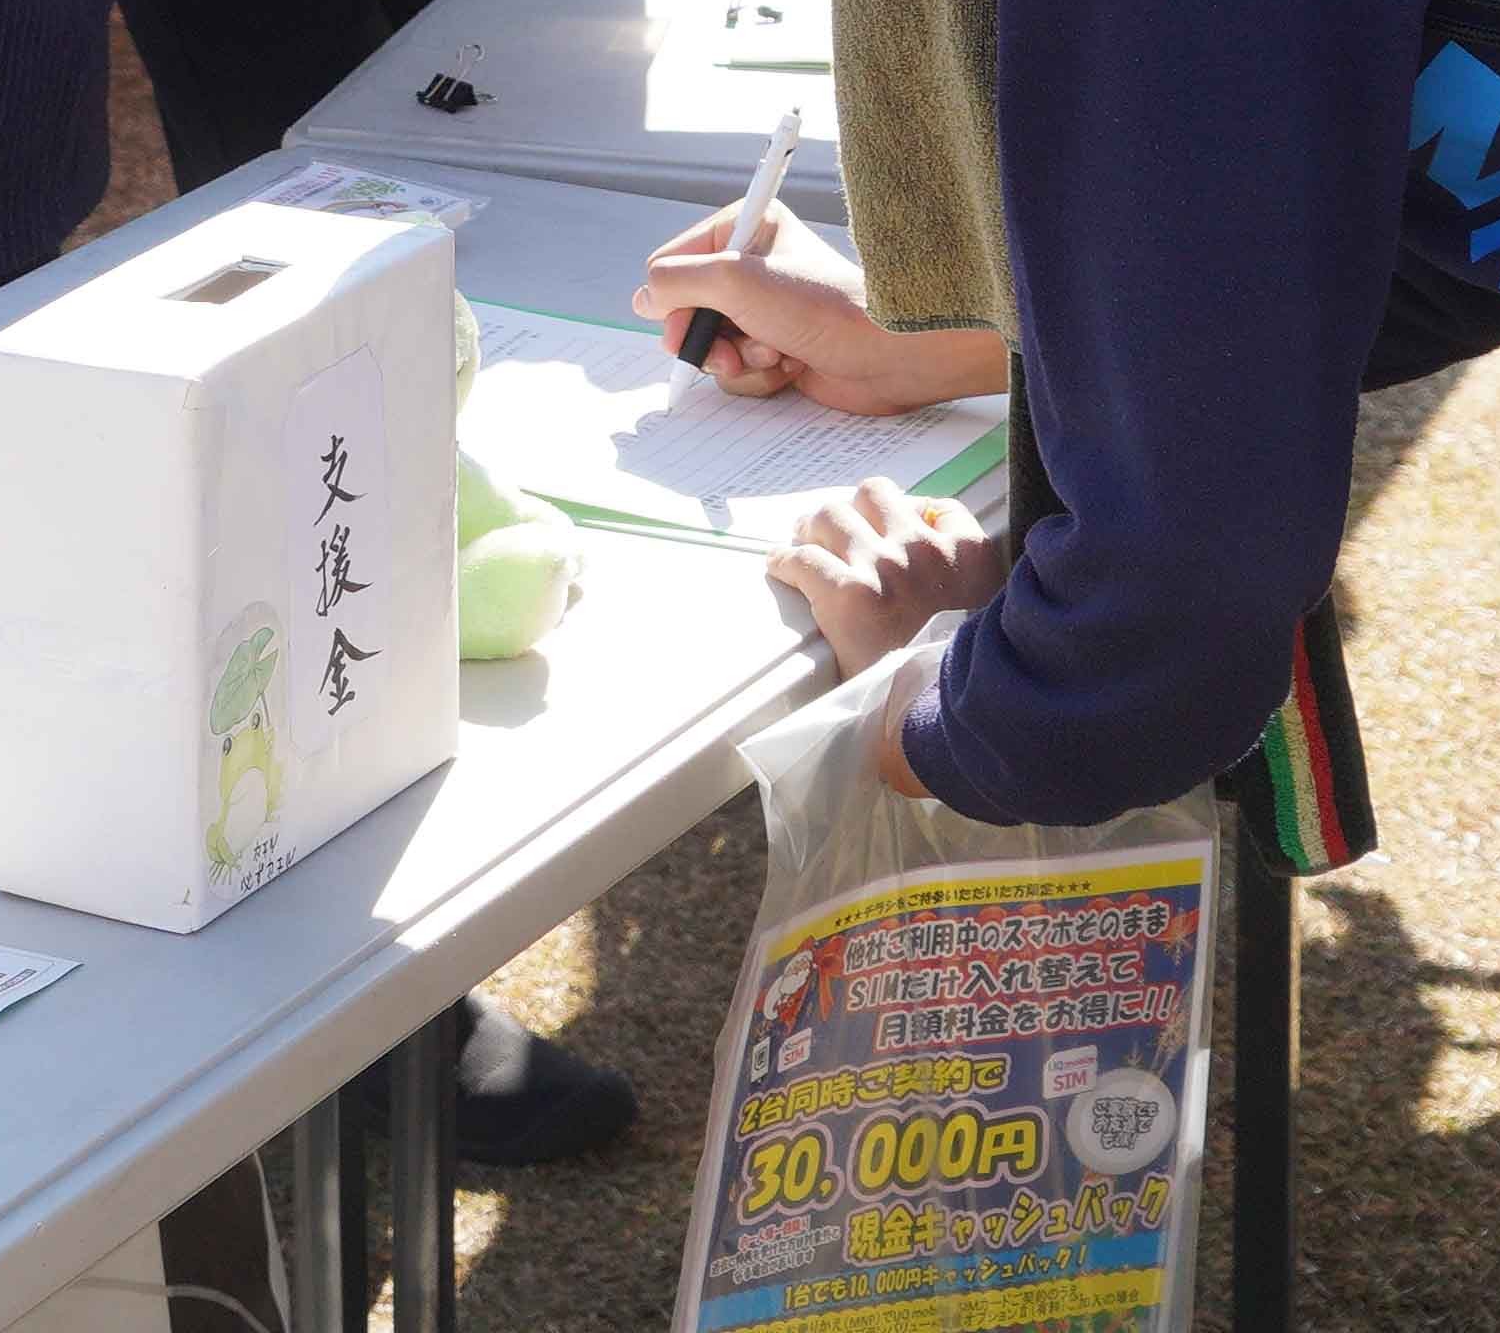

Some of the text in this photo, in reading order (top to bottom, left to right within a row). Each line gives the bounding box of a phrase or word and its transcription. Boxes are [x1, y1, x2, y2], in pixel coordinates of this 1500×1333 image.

[313, 433, 383, 717] 支援金
[1053, 1071, 1088, 1093] SIM
[846, 1177, 1172, 1262] 現金キャッシュバック
